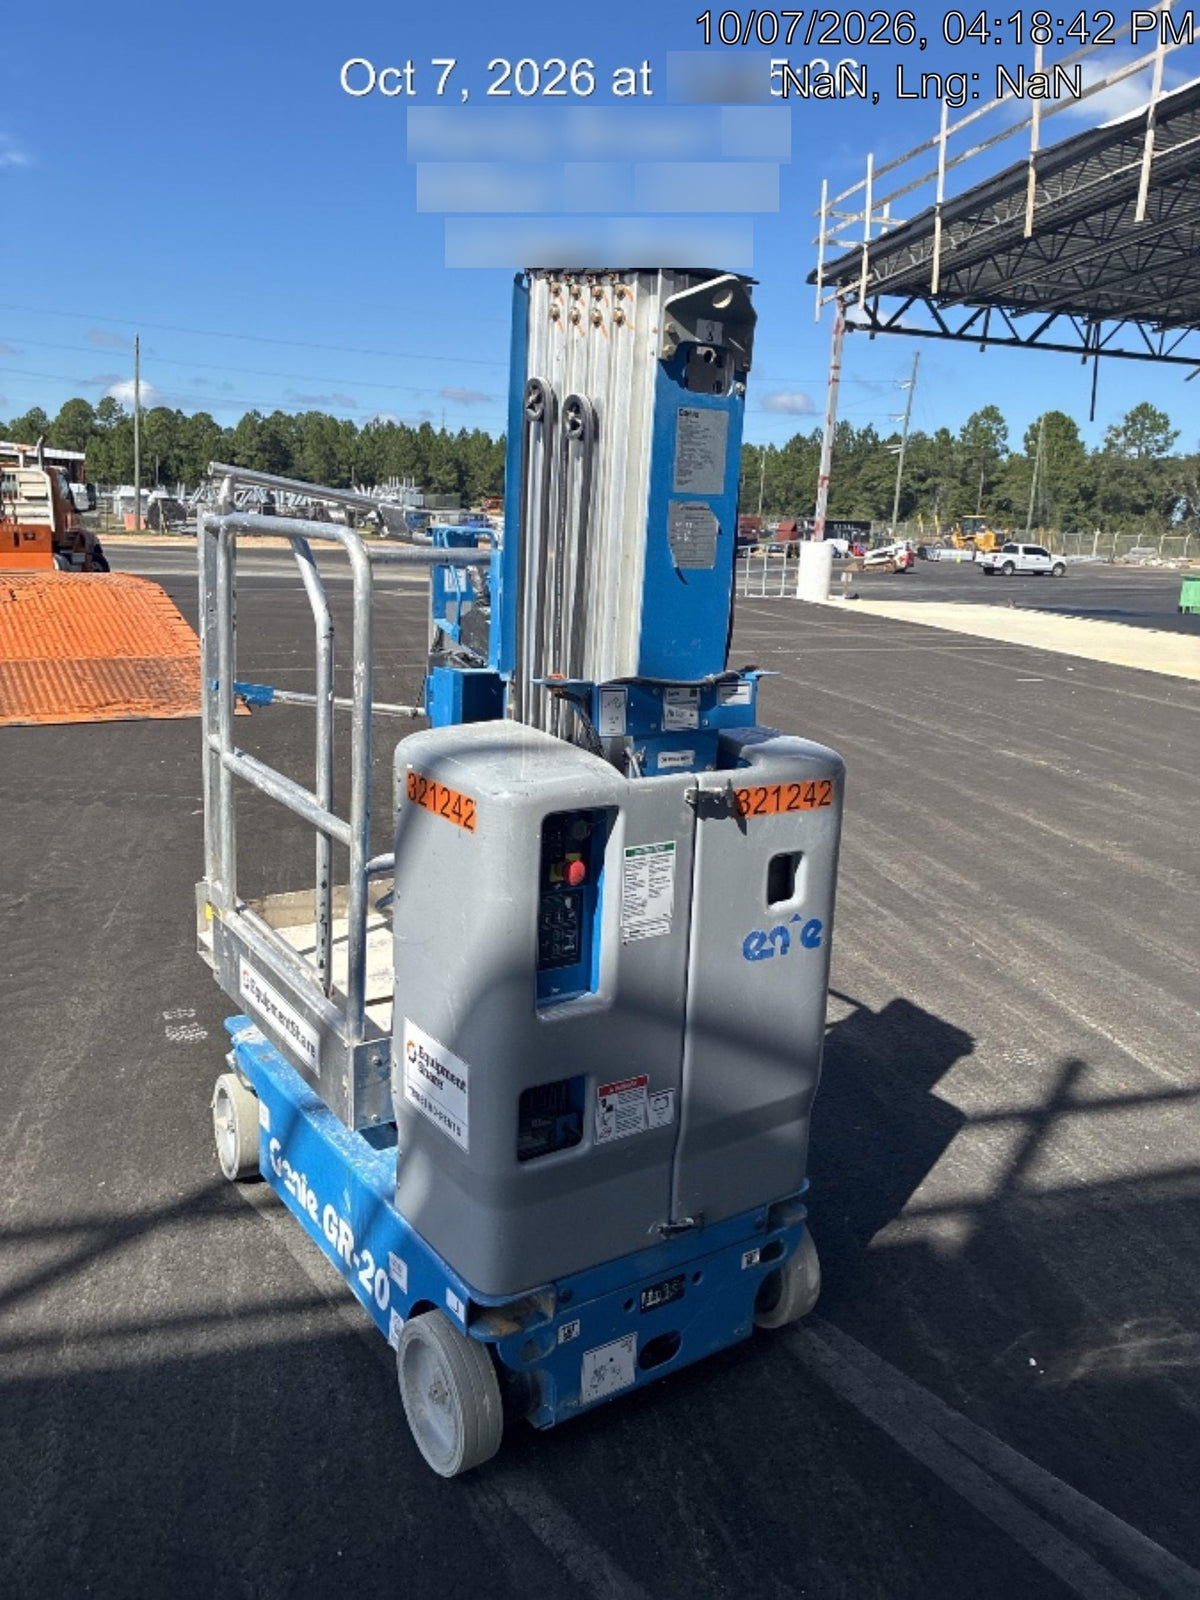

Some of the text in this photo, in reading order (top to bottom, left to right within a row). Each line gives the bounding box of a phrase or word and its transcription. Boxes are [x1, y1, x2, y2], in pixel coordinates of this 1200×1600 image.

[407, 772, 475, 831] 321242
[736, 779, 832, 817] 321242
[322, 1203, 391, 1311] GR-20
